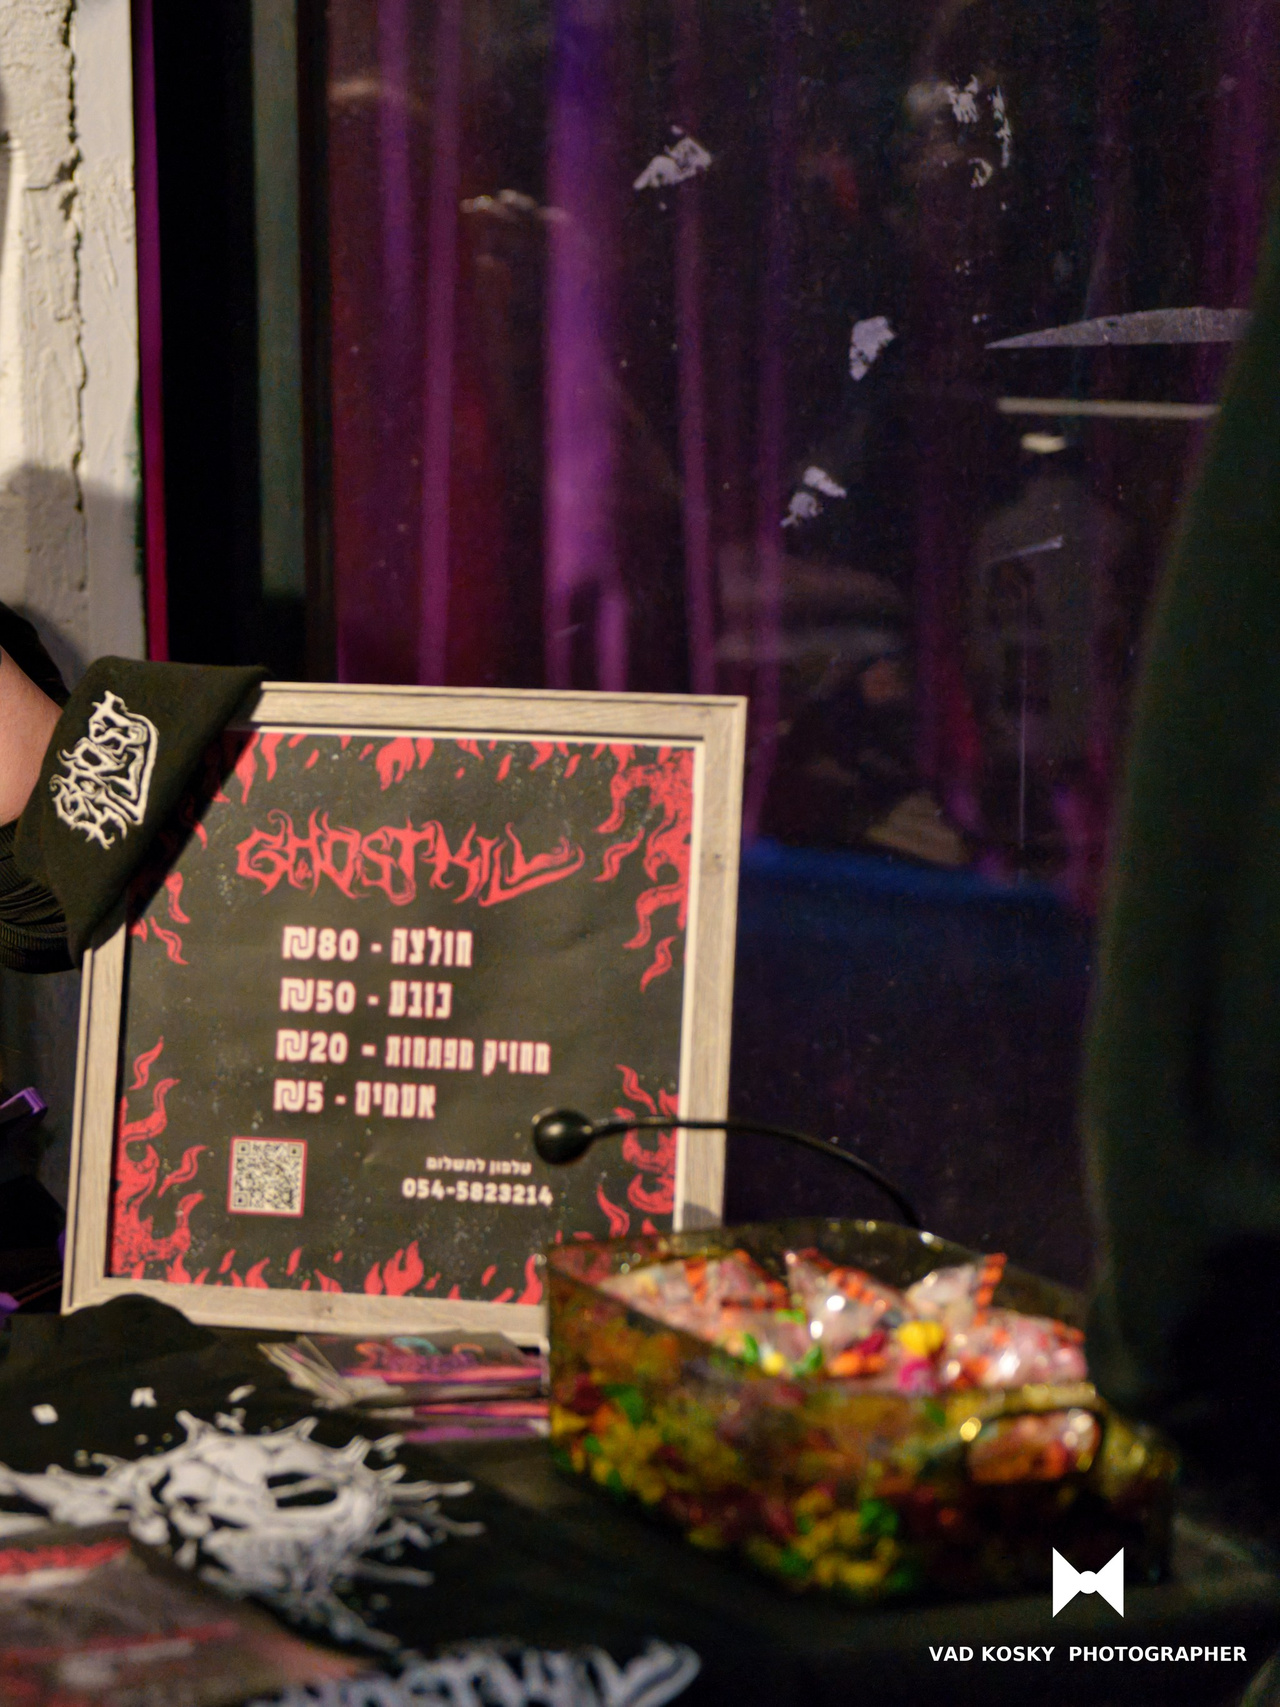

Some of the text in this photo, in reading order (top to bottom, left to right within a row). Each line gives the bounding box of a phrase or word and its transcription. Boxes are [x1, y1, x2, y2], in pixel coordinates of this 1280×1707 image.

[391, 926, 473, 967] חולצה
[388, 980, 452, 1019] כובע
[384, 1034, 475, 1071] מפתחות
[482, 1039, 551, 1077] מחזיק
[425, 1155, 532, 1177] טלפון לתשלום
[401, 1177, 554, 1208] 054-5823214
